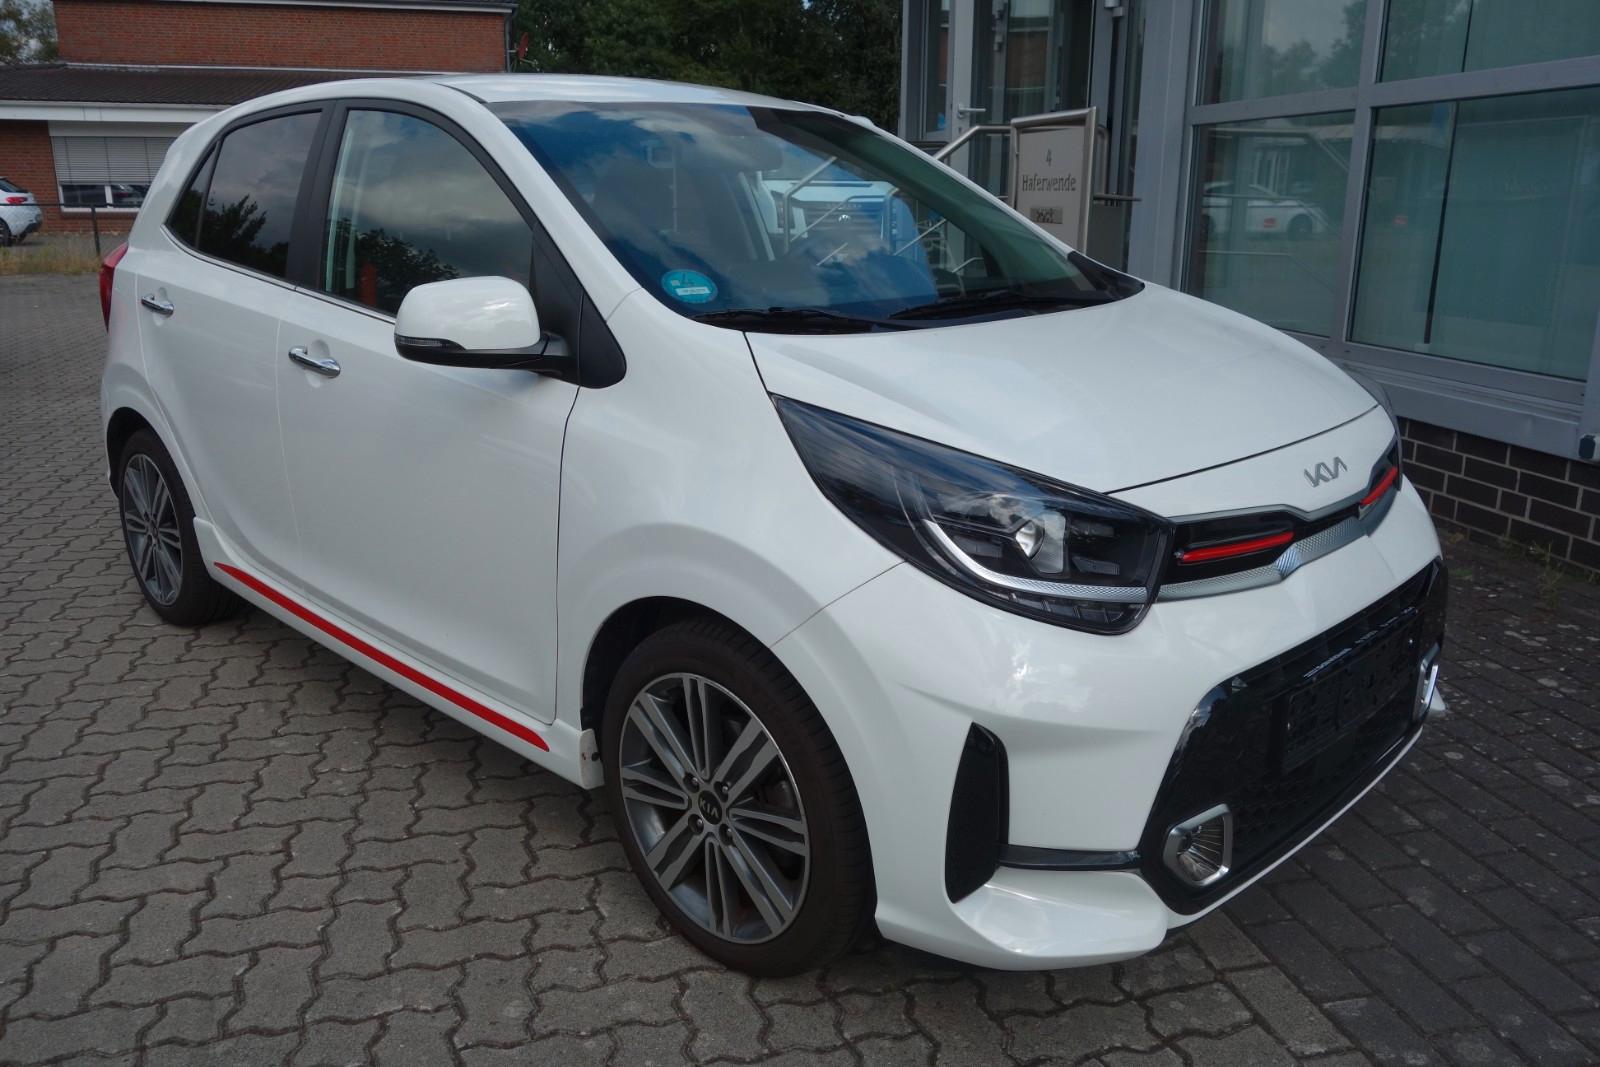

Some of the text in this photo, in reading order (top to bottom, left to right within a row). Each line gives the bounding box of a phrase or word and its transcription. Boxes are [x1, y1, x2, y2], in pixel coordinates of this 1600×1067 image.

[1045, 148, 1053, 167] 4
[1022, 172, 1077, 192] Haferwende
[699, 797, 719, 819] KIA
